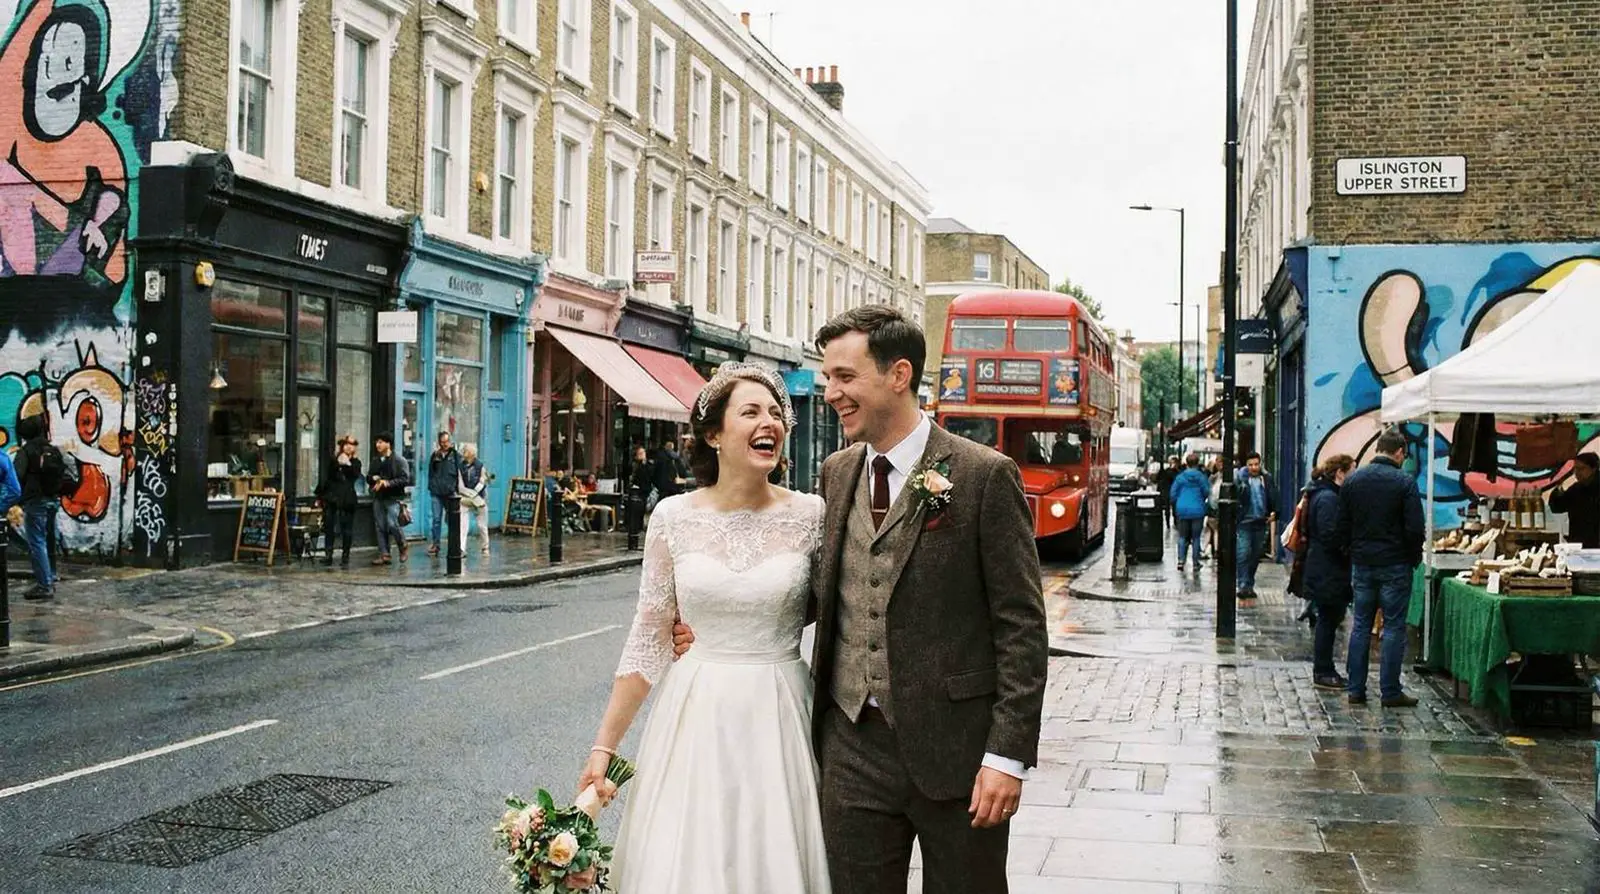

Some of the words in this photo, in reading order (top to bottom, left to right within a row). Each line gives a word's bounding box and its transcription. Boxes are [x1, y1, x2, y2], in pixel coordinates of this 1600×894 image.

[1360, 161, 1442, 175] ISLINGTON
[1344, 177, 1393, 190] UPPER
[1400, 176, 1458, 190] STREET
[978, 362, 995, 379] 16
